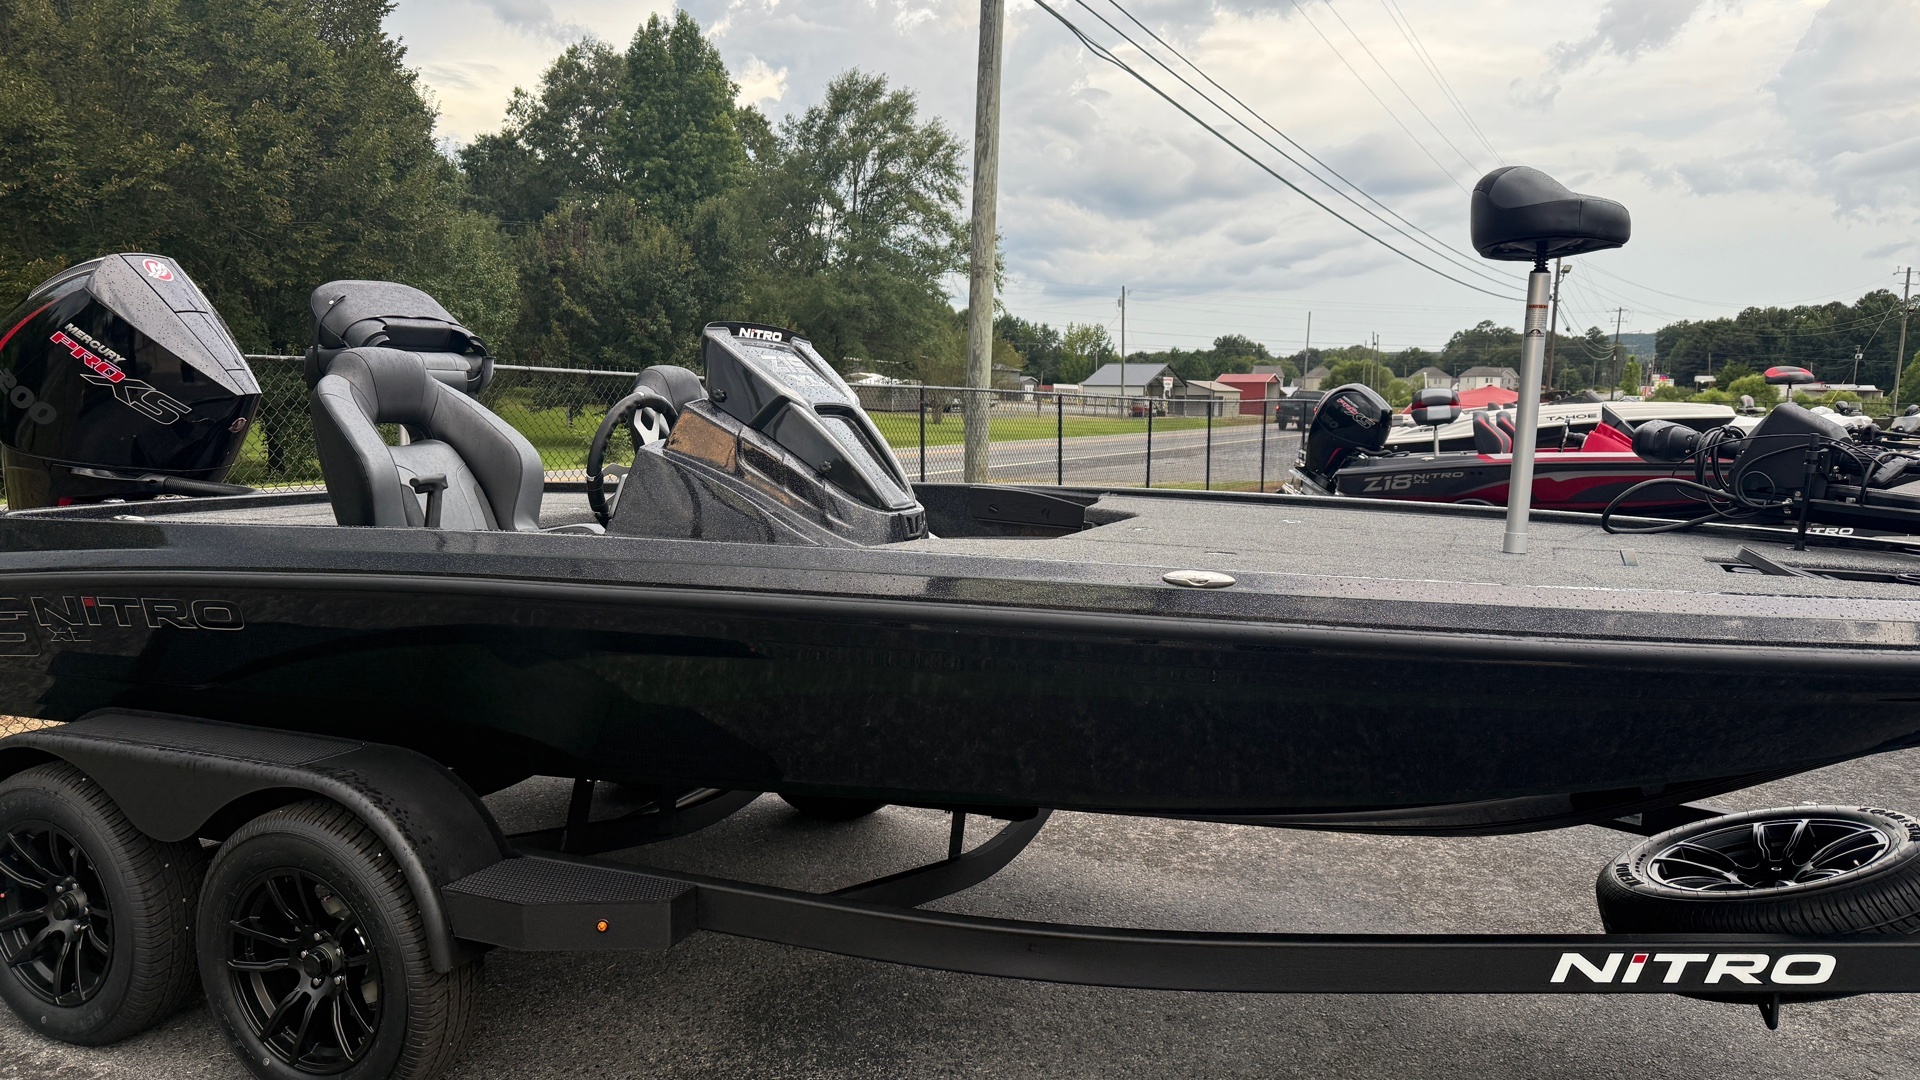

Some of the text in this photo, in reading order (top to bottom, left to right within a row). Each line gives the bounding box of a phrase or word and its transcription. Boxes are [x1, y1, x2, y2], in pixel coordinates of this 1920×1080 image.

[49, 331, 126, 383] PRO
[64, 322, 127, 364] MERCURY
[79, 373, 193, 425] XS
[1546, 413, 1597, 421] TAHOE
[1363, 474, 1413, 492] Z18
[46, 627, 92, 642] XL
